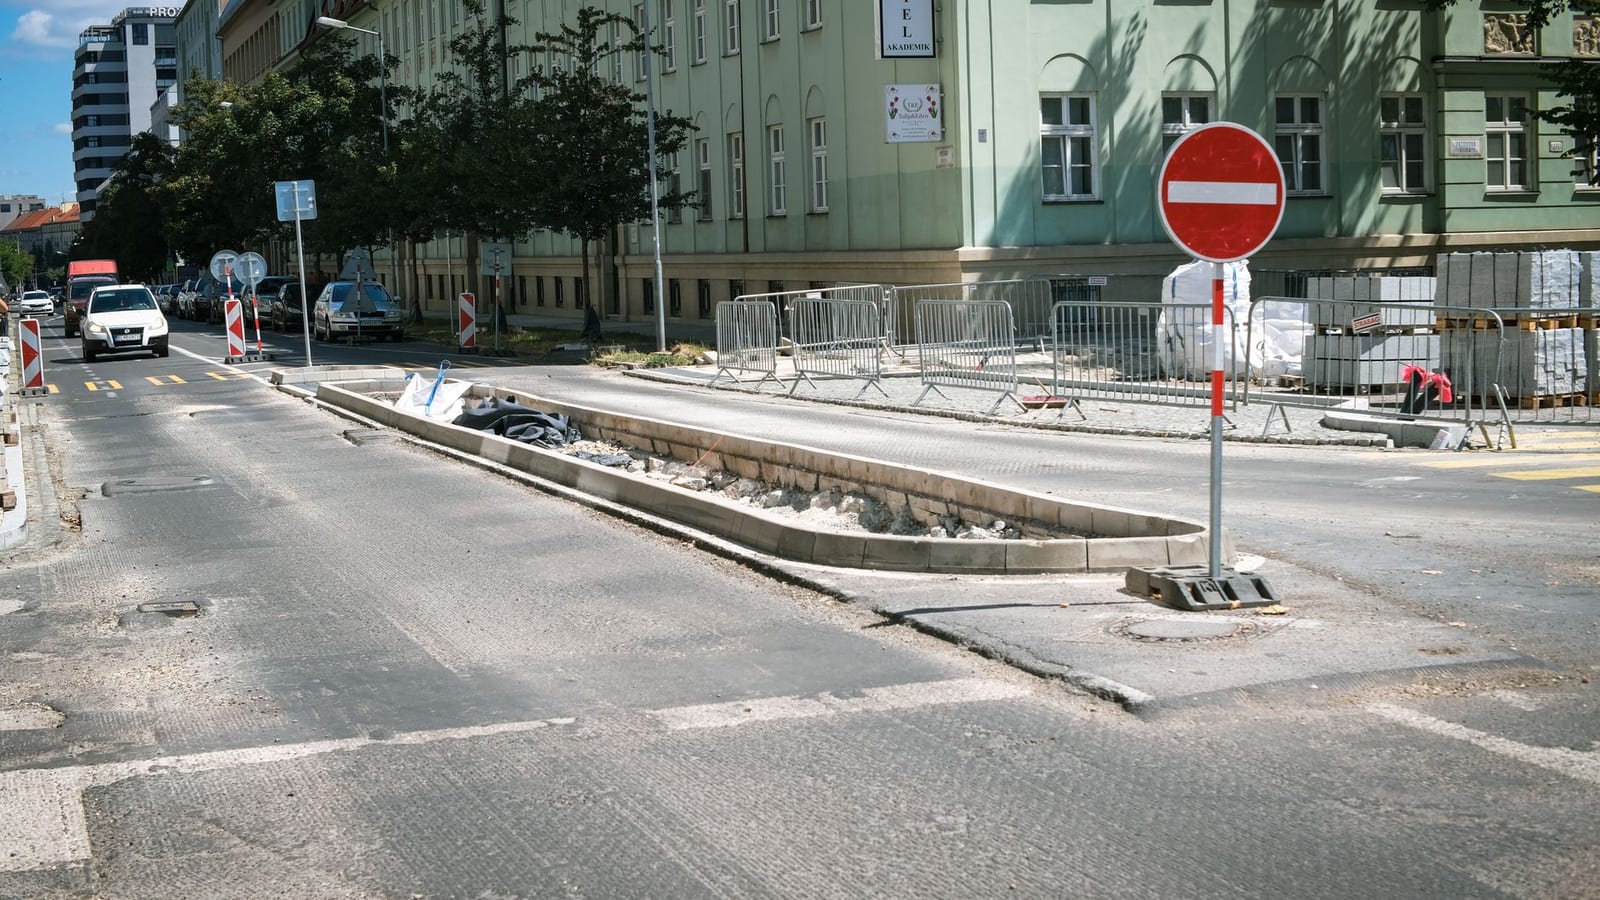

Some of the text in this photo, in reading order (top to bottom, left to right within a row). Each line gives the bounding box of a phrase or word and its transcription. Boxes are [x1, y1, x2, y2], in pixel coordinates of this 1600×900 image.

[150, 7, 182, 17] PRO
[887, 43, 930, 51] AKADEMIK
[1354, 316, 1380, 328] STRABAG
